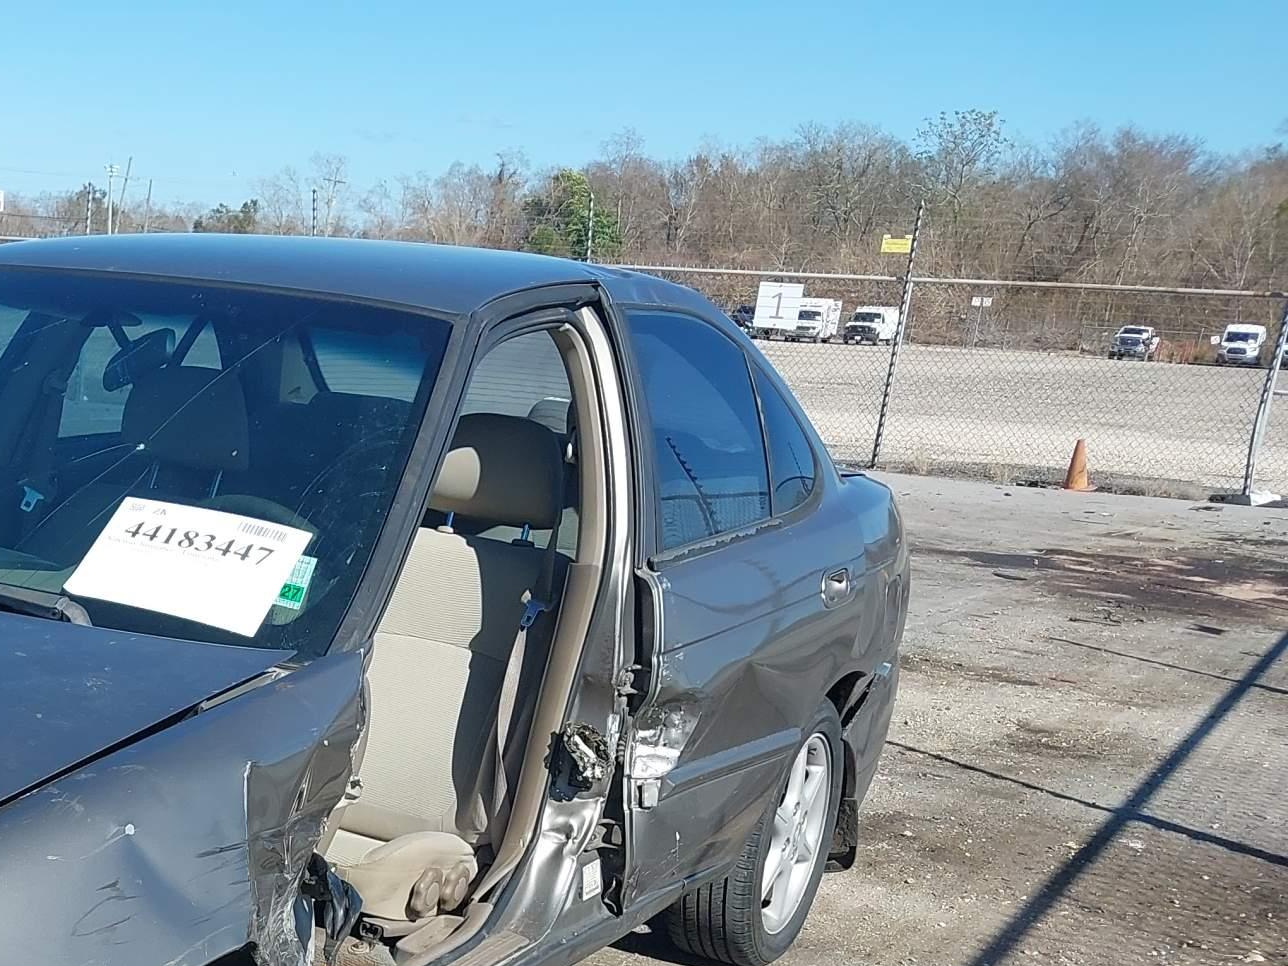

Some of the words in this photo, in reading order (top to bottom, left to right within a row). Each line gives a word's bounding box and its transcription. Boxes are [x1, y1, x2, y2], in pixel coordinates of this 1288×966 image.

[768, 292, 785, 320] 1
[124, 521, 275, 566] 44183447
[279, 584, 302, 600] 27
